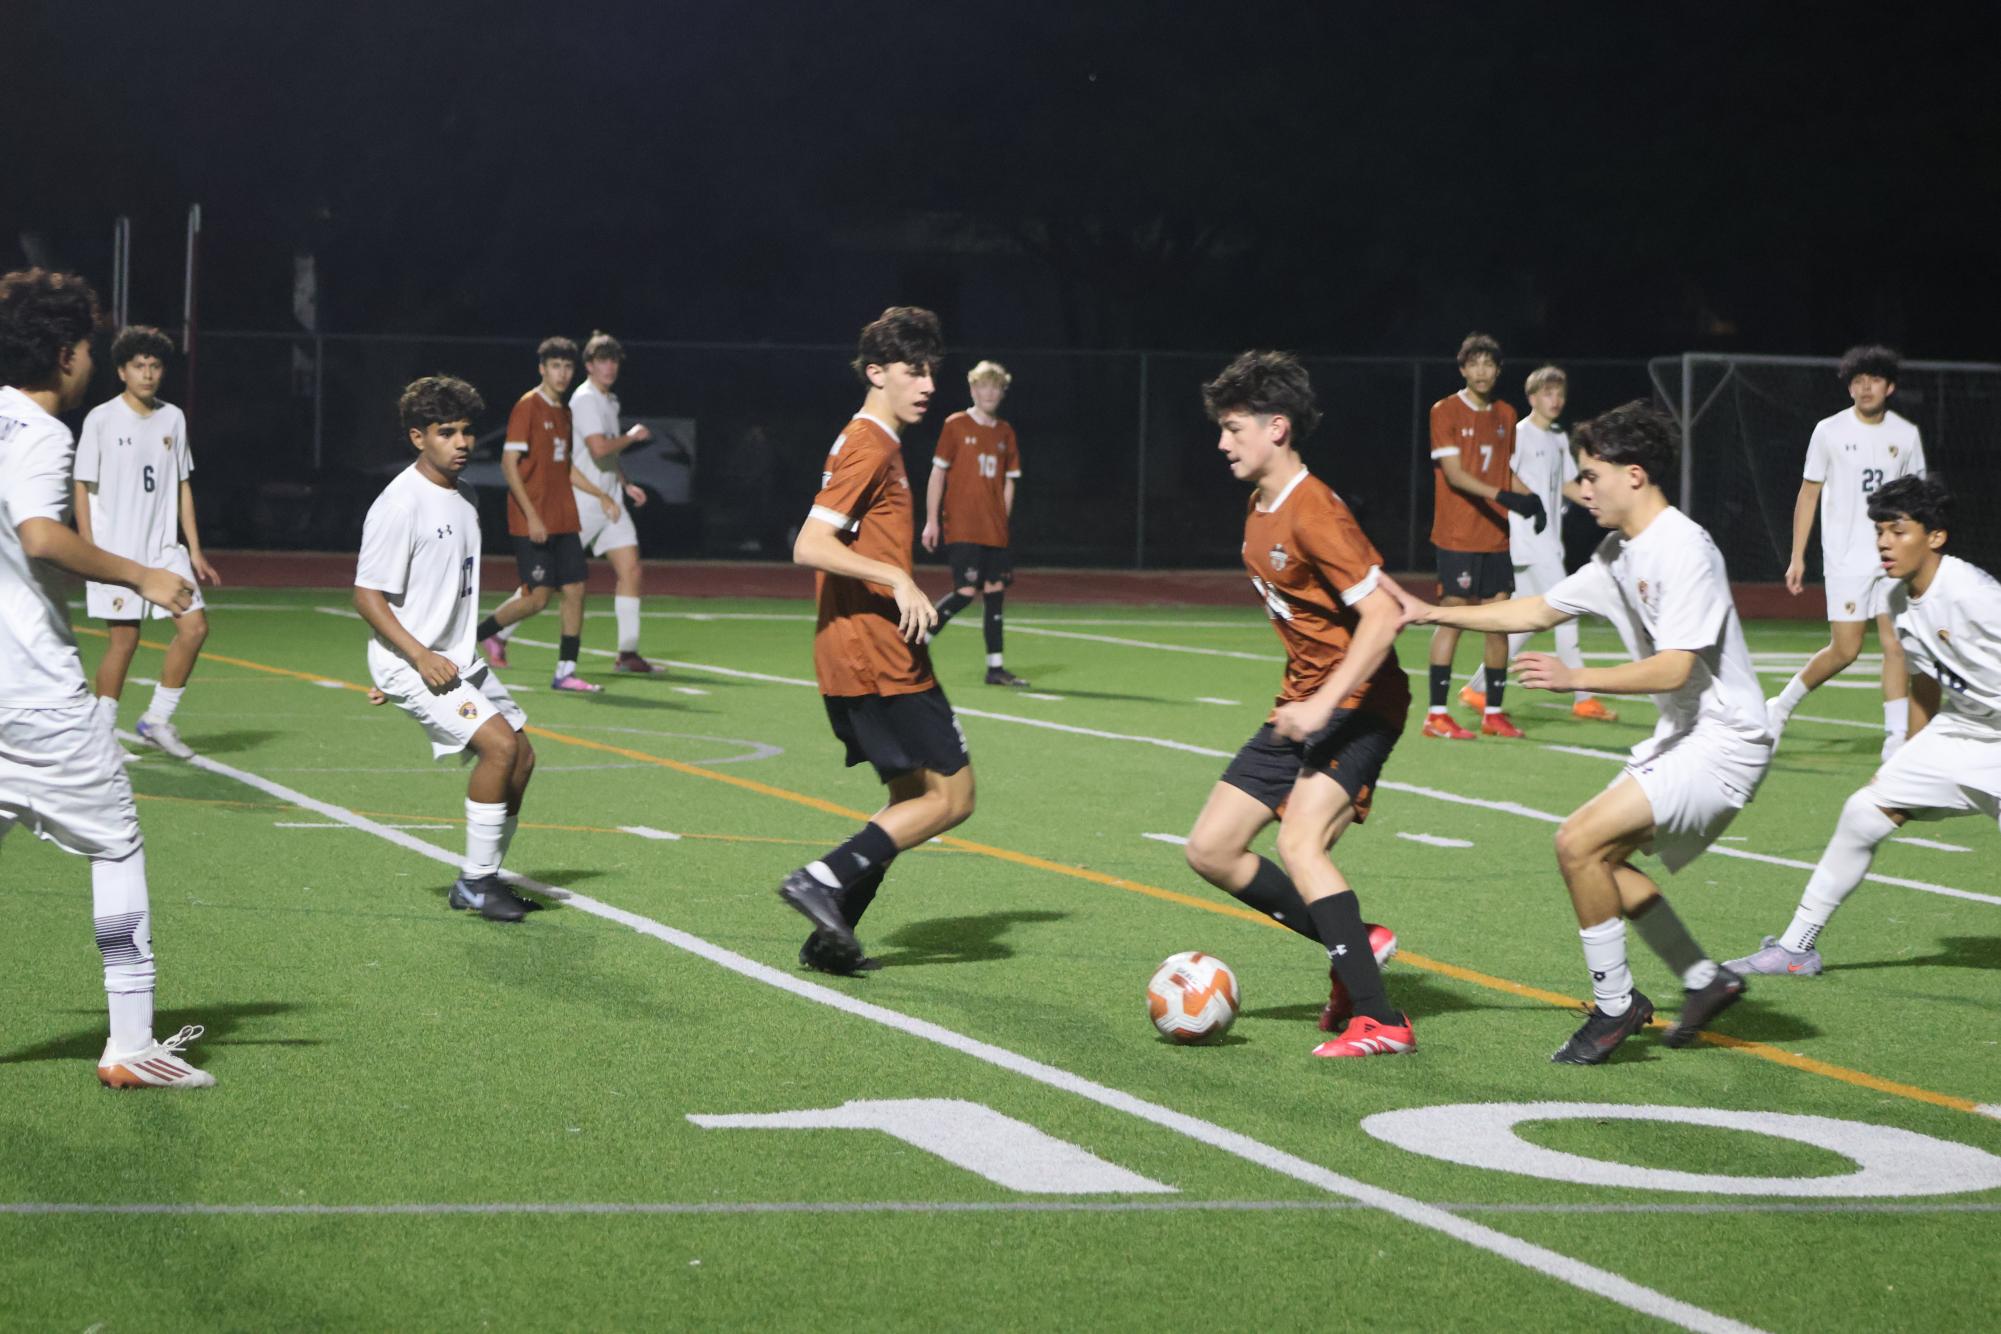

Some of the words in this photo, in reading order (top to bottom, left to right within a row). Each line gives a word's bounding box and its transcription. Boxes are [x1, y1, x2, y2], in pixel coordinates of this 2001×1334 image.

[977, 453, 998, 478] 10
[1480, 445, 1493, 473] 7
[143, 465, 155, 493] 6
